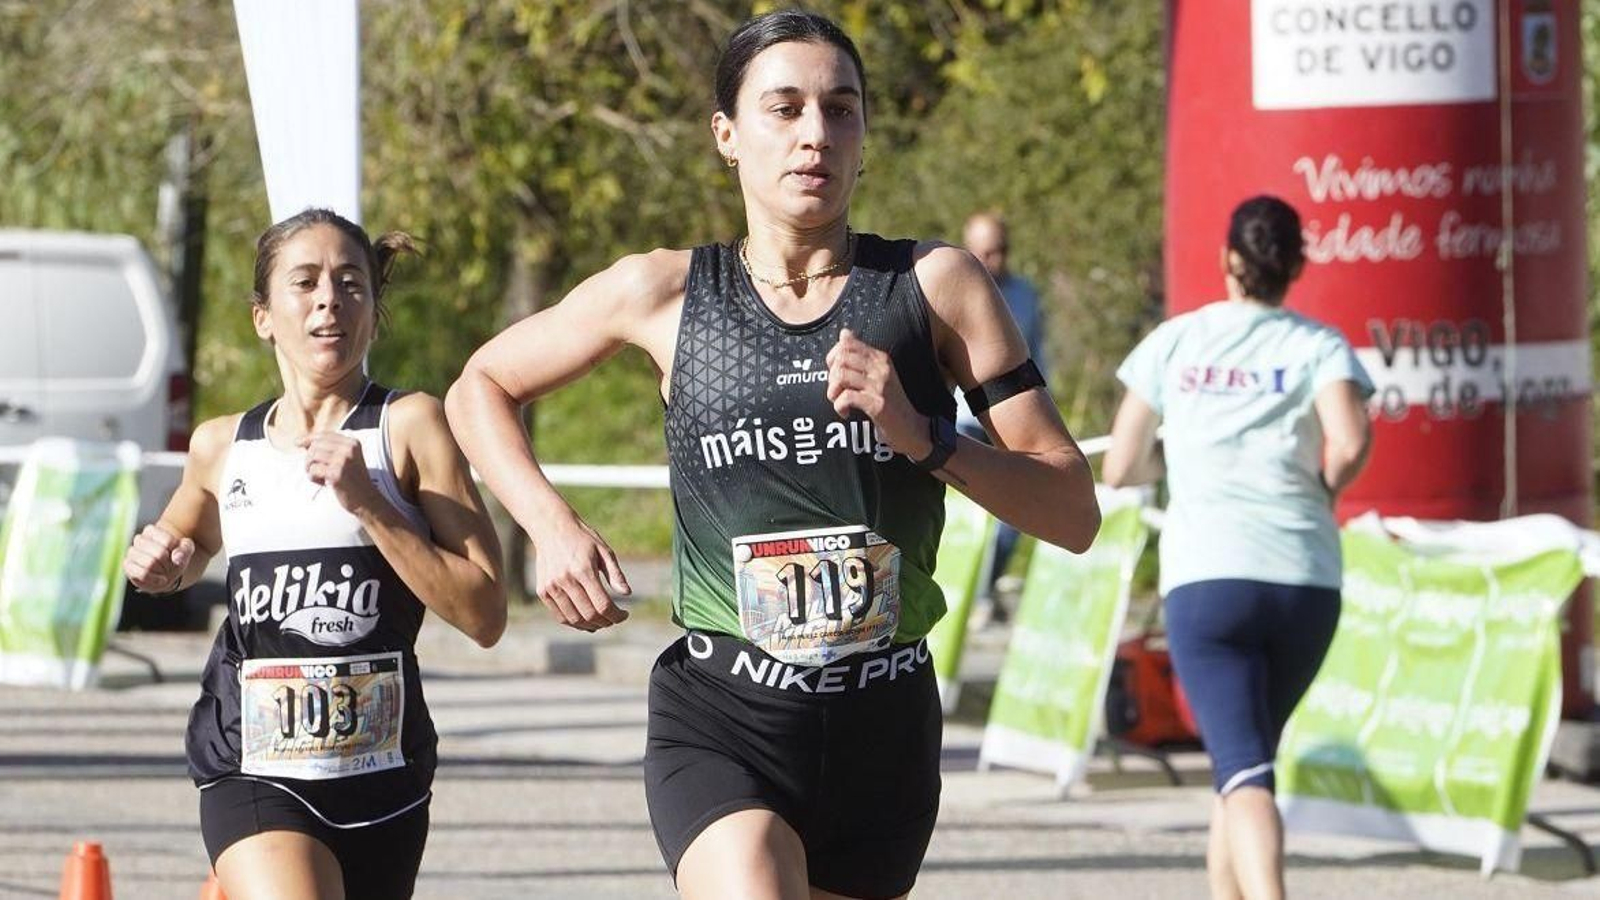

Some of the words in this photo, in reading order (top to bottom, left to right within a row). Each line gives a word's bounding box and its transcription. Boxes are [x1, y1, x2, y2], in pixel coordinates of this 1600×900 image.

[1270, 1, 1479, 34] CONCELLO
[1295, 46, 1343, 74] DE
[1360, 40, 1456, 73] VIGO
[1293, 153, 1453, 203] Vivimos
[1301, 212, 1424, 265] idade
[776, 369, 828, 385] amura
[1429, 374, 1486, 421] de
[700, 418, 789, 469] máis
[792, 416, 823, 465] que
[234, 562, 381, 625] delikia
[776, 556, 875, 625] 119
[311, 616, 354, 634] fresh
[730, 651, 851, 694] NIKE
[271, 684, 358, 740] 103
